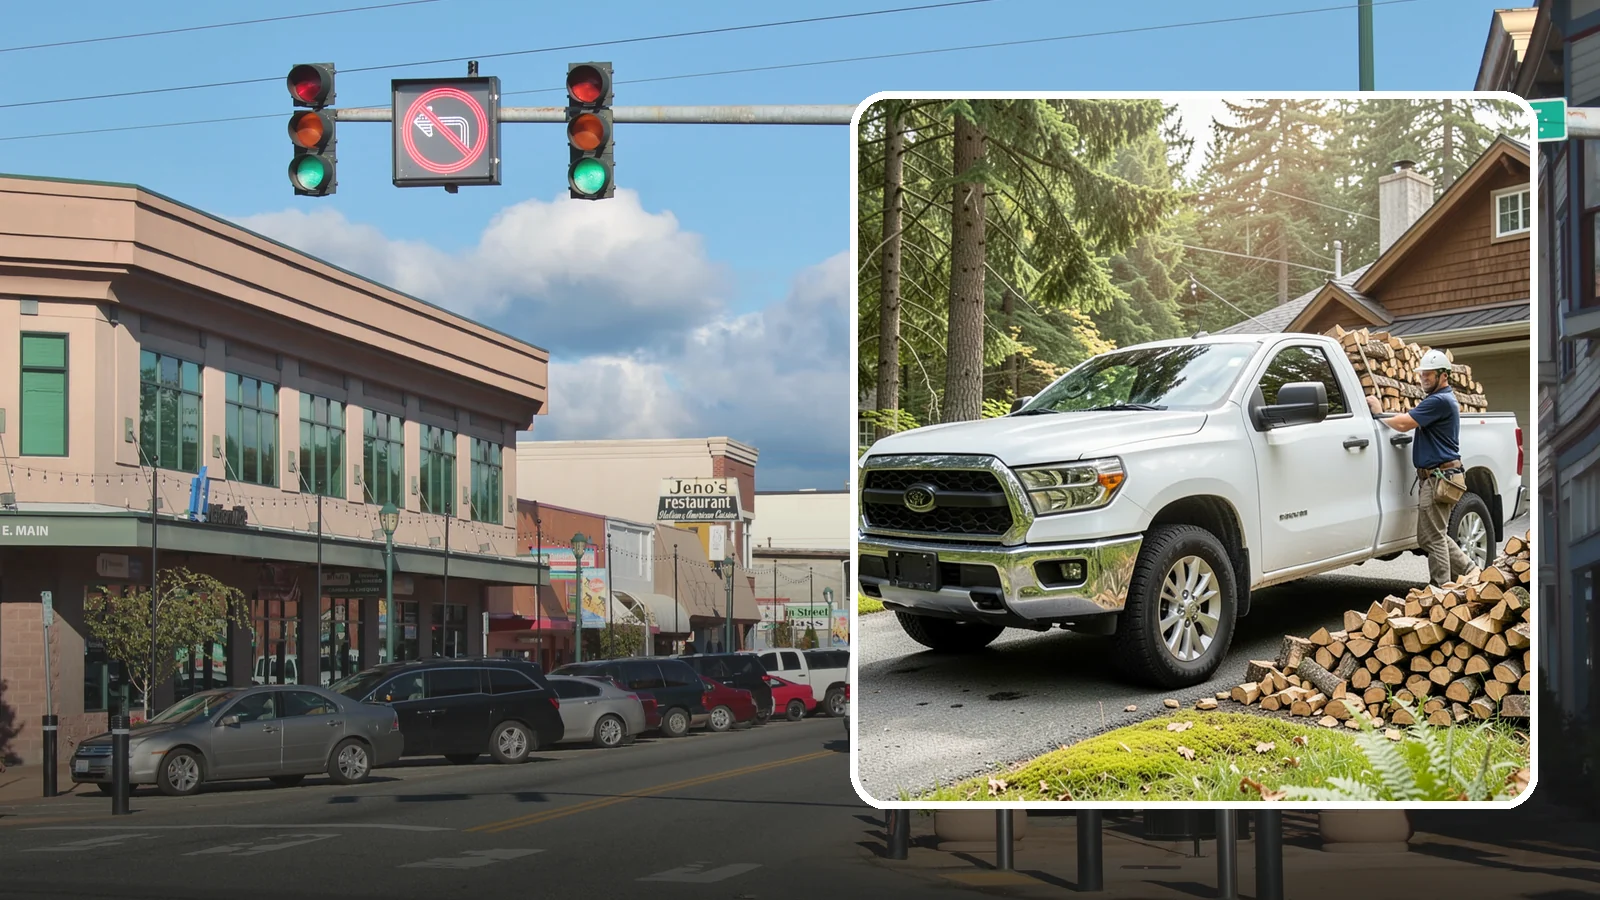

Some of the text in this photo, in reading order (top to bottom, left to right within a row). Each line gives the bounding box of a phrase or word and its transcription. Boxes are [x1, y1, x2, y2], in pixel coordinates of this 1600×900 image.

[670, 480, 727, 494] Jeno's
[665, 496, 731, 509] restaurant
[659, 510, 681, 519] Italian
[686, 509, 714, 519] American
[715, 509, 738, 519] Cuisine
[2, 525, 49, 536] E. MAIN
[797, 607, 828, 617] Street
[791, 619, 824, 627] lass
